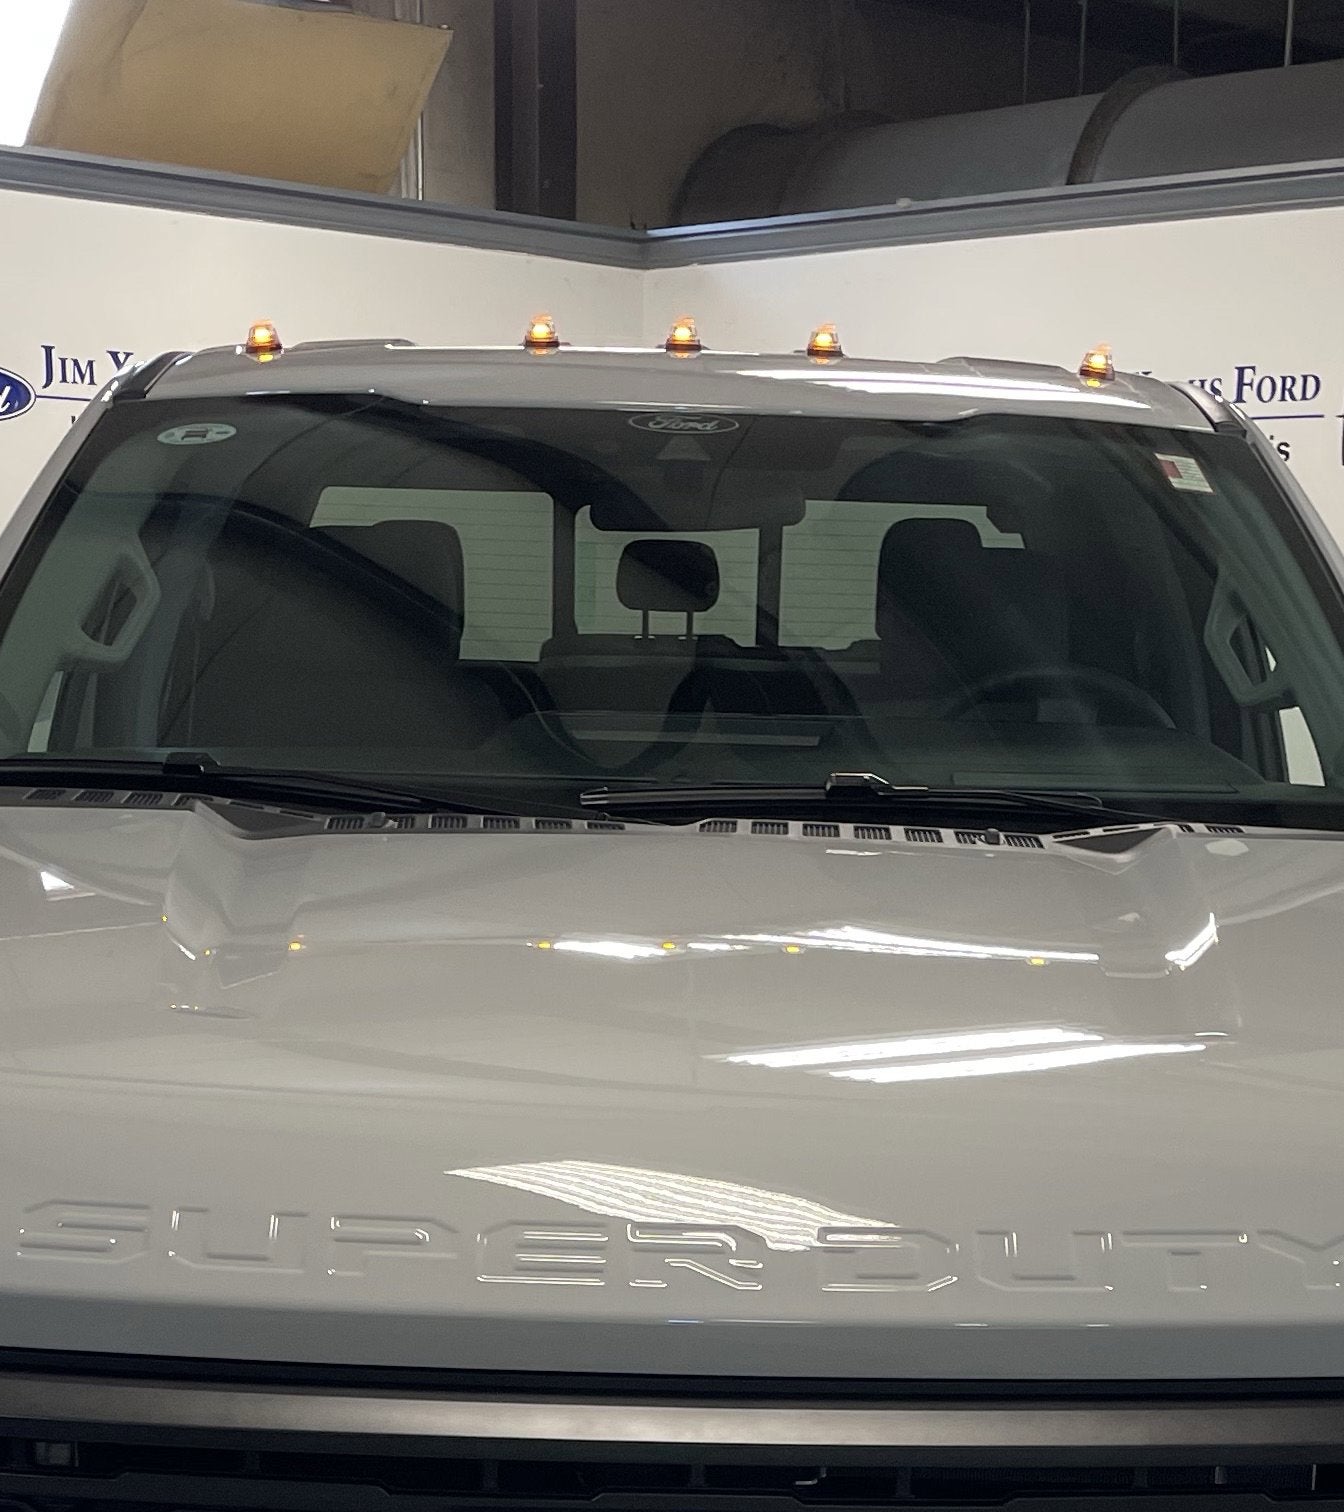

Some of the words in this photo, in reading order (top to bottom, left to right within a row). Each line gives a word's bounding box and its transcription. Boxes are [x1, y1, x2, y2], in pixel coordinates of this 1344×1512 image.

[40, 344, 97, 389] JIM
[1233, 364, 1322, 405] FORD
[647, 414, 721, 432] Ford
[16, 1201, 764, 1291] SUPER
